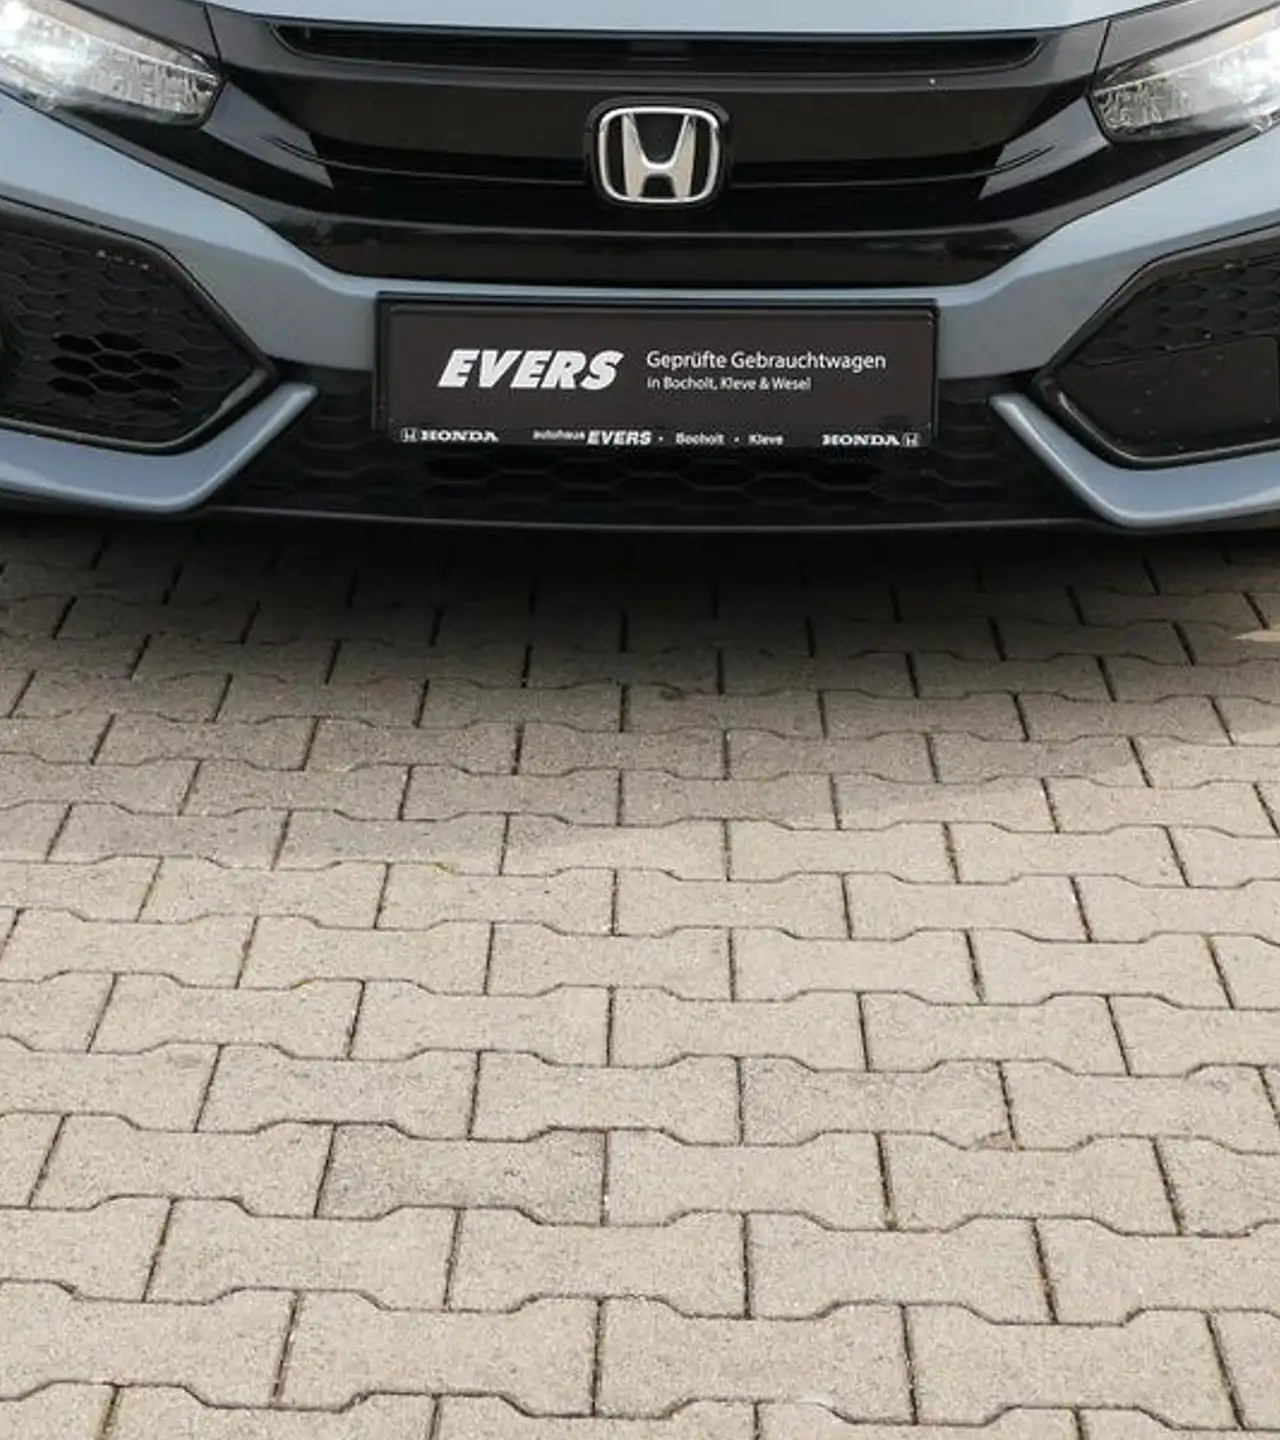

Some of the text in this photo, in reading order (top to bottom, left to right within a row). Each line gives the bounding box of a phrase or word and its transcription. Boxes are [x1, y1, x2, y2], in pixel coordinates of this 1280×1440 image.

[437, 348, 624, 391] EVERS
[646, 349, 887, 374] Geprüfte Gebrauchtwagen
[647, 376, 812, 392] in Bocholt, Kleve & Wesel
[419, 428, 500, 443] HONDA
[585, 429, 652, 446] EVERS
[675, 431, 725, 446] Bocholt
[748, 432, 785, 446] Kleve
[822, 433, 901, 447] HONDA
